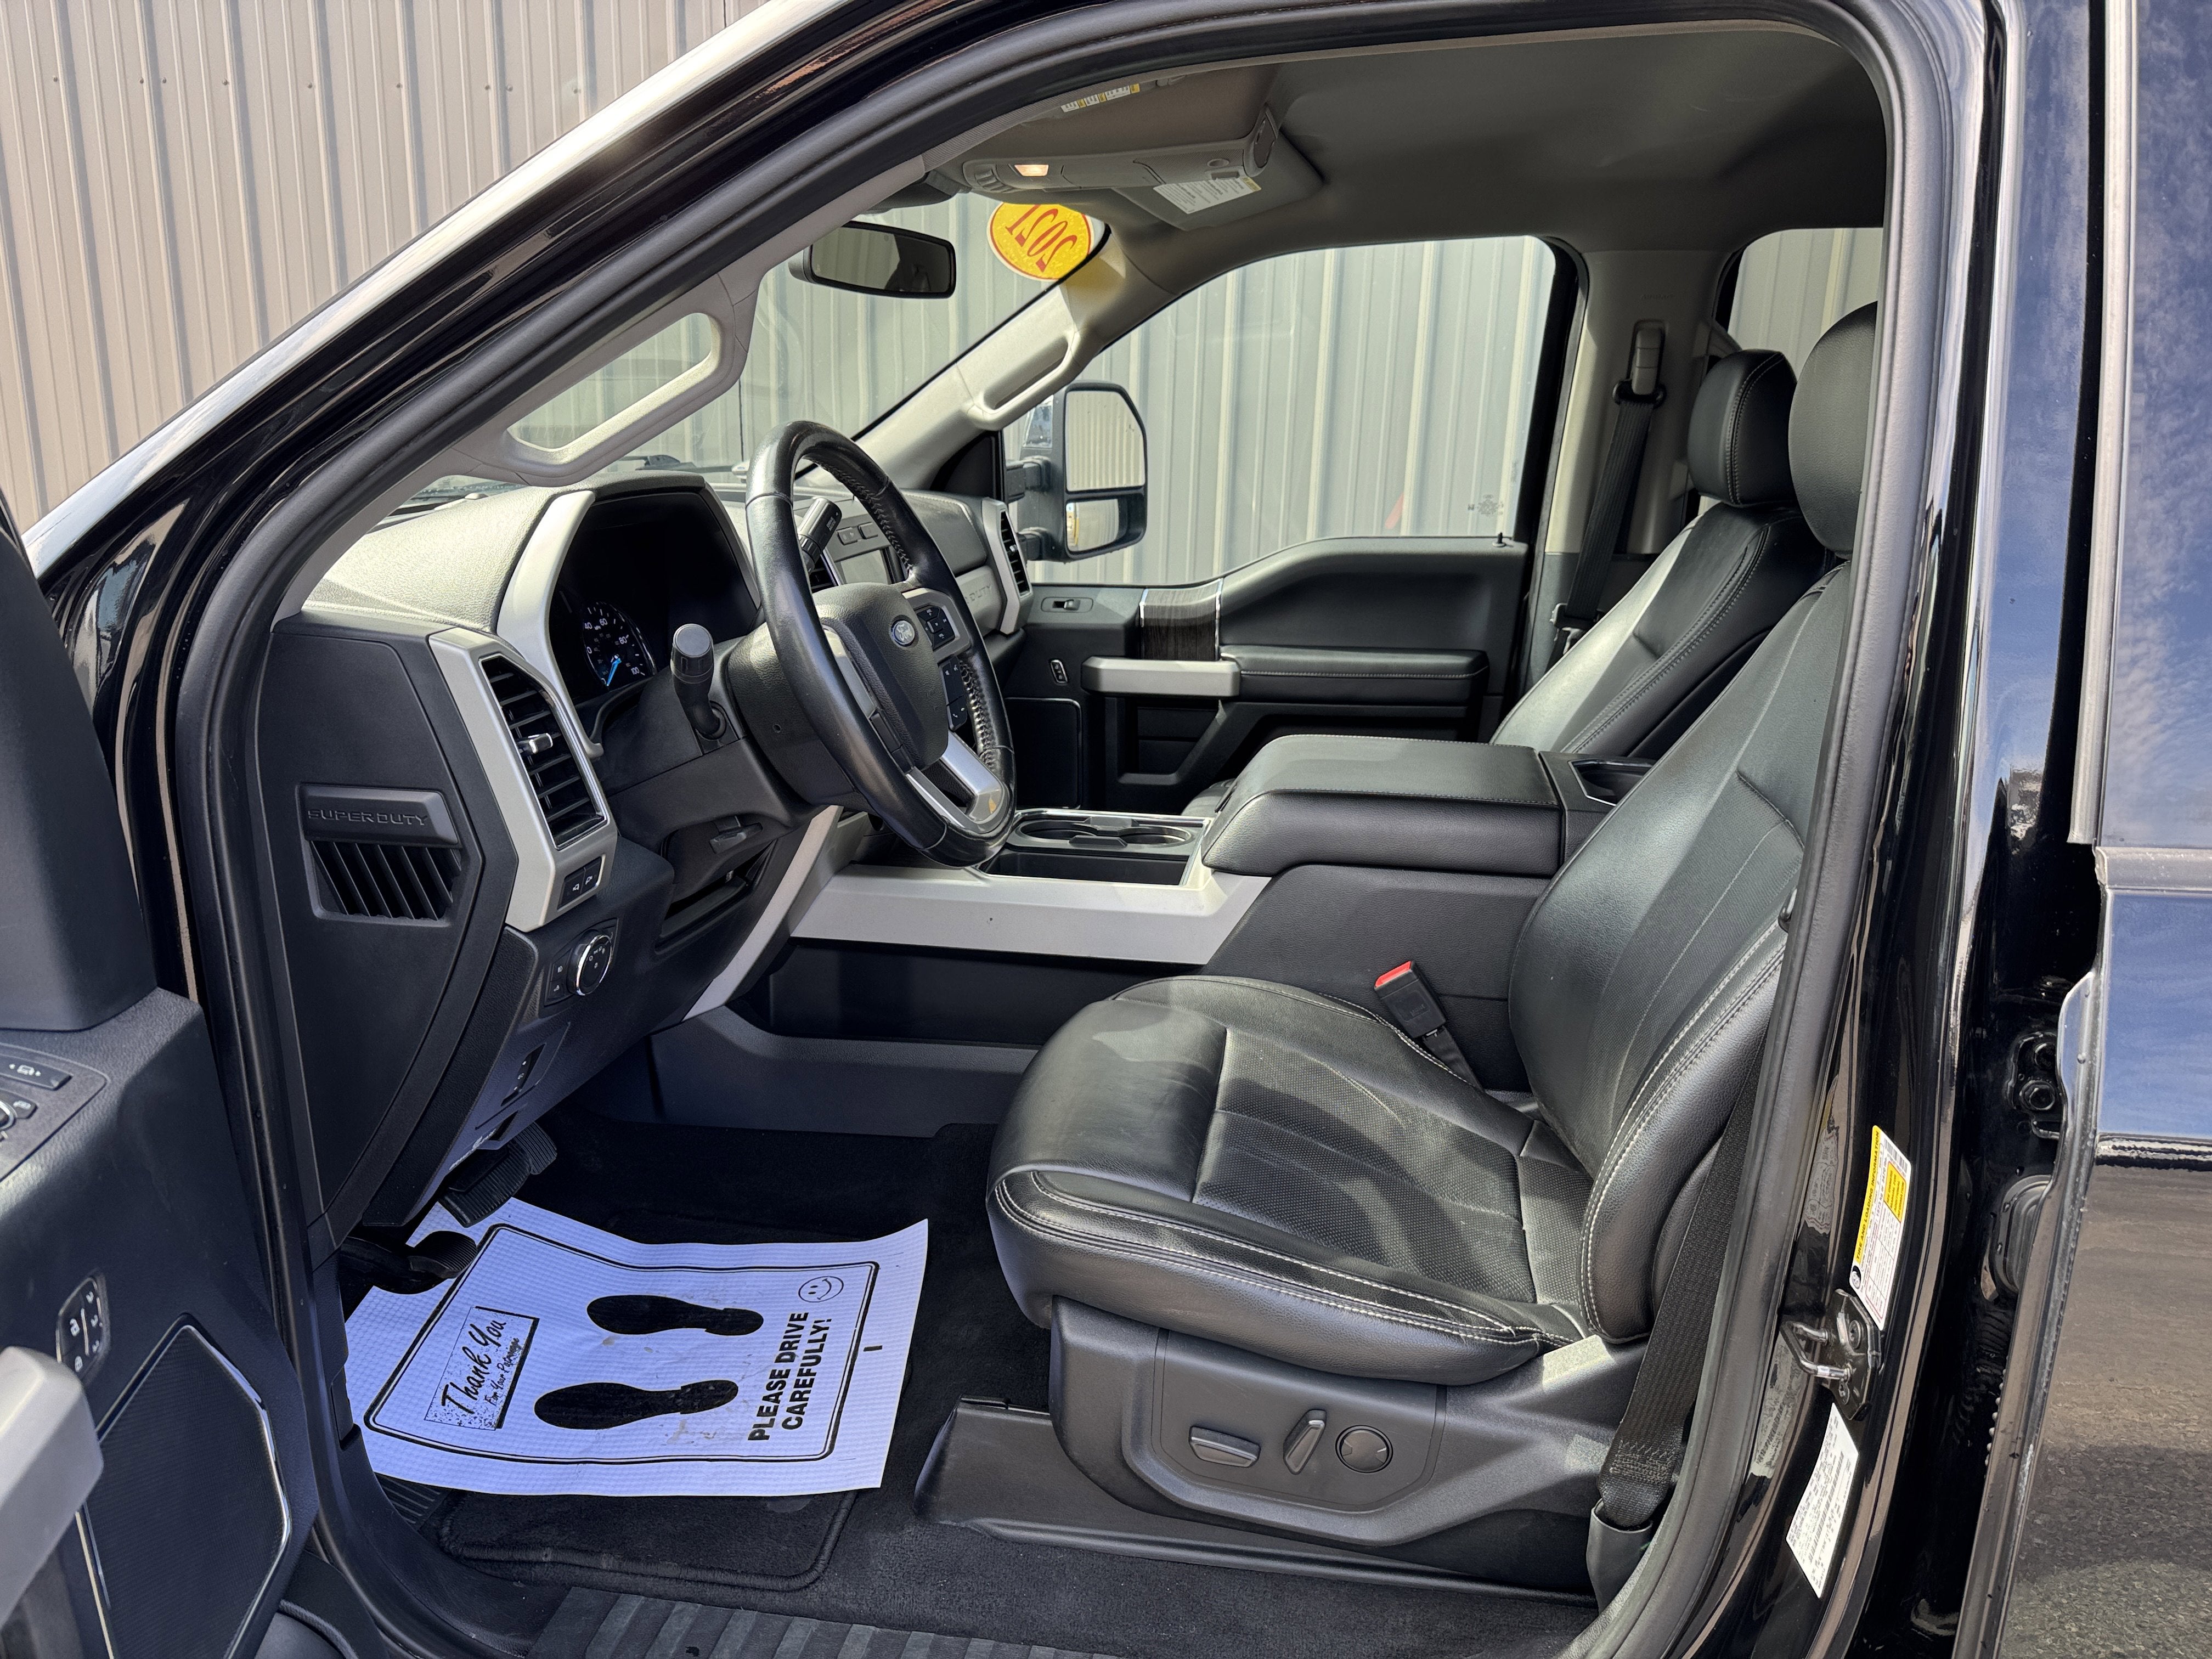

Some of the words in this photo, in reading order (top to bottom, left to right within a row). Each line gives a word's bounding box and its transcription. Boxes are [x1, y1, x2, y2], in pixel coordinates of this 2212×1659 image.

[896, 623, 912, 640] Ford
[1864, 1188, 1873, 1223] LOADING
[1871, 1131, 1879, 1187] INFORMATION
[441, 1346, 492, 1414] Thank
[468, 1320, 506, 1346] You
[484, 1392, 498, 1406] For
[490, 1374, 506, 1390] Your
[747, 1369, 791, 1441] PLEASE
[774, 1312, 809, 1363] DRIVE
[781, 1319, 832, 1430] CAREFULLY!
